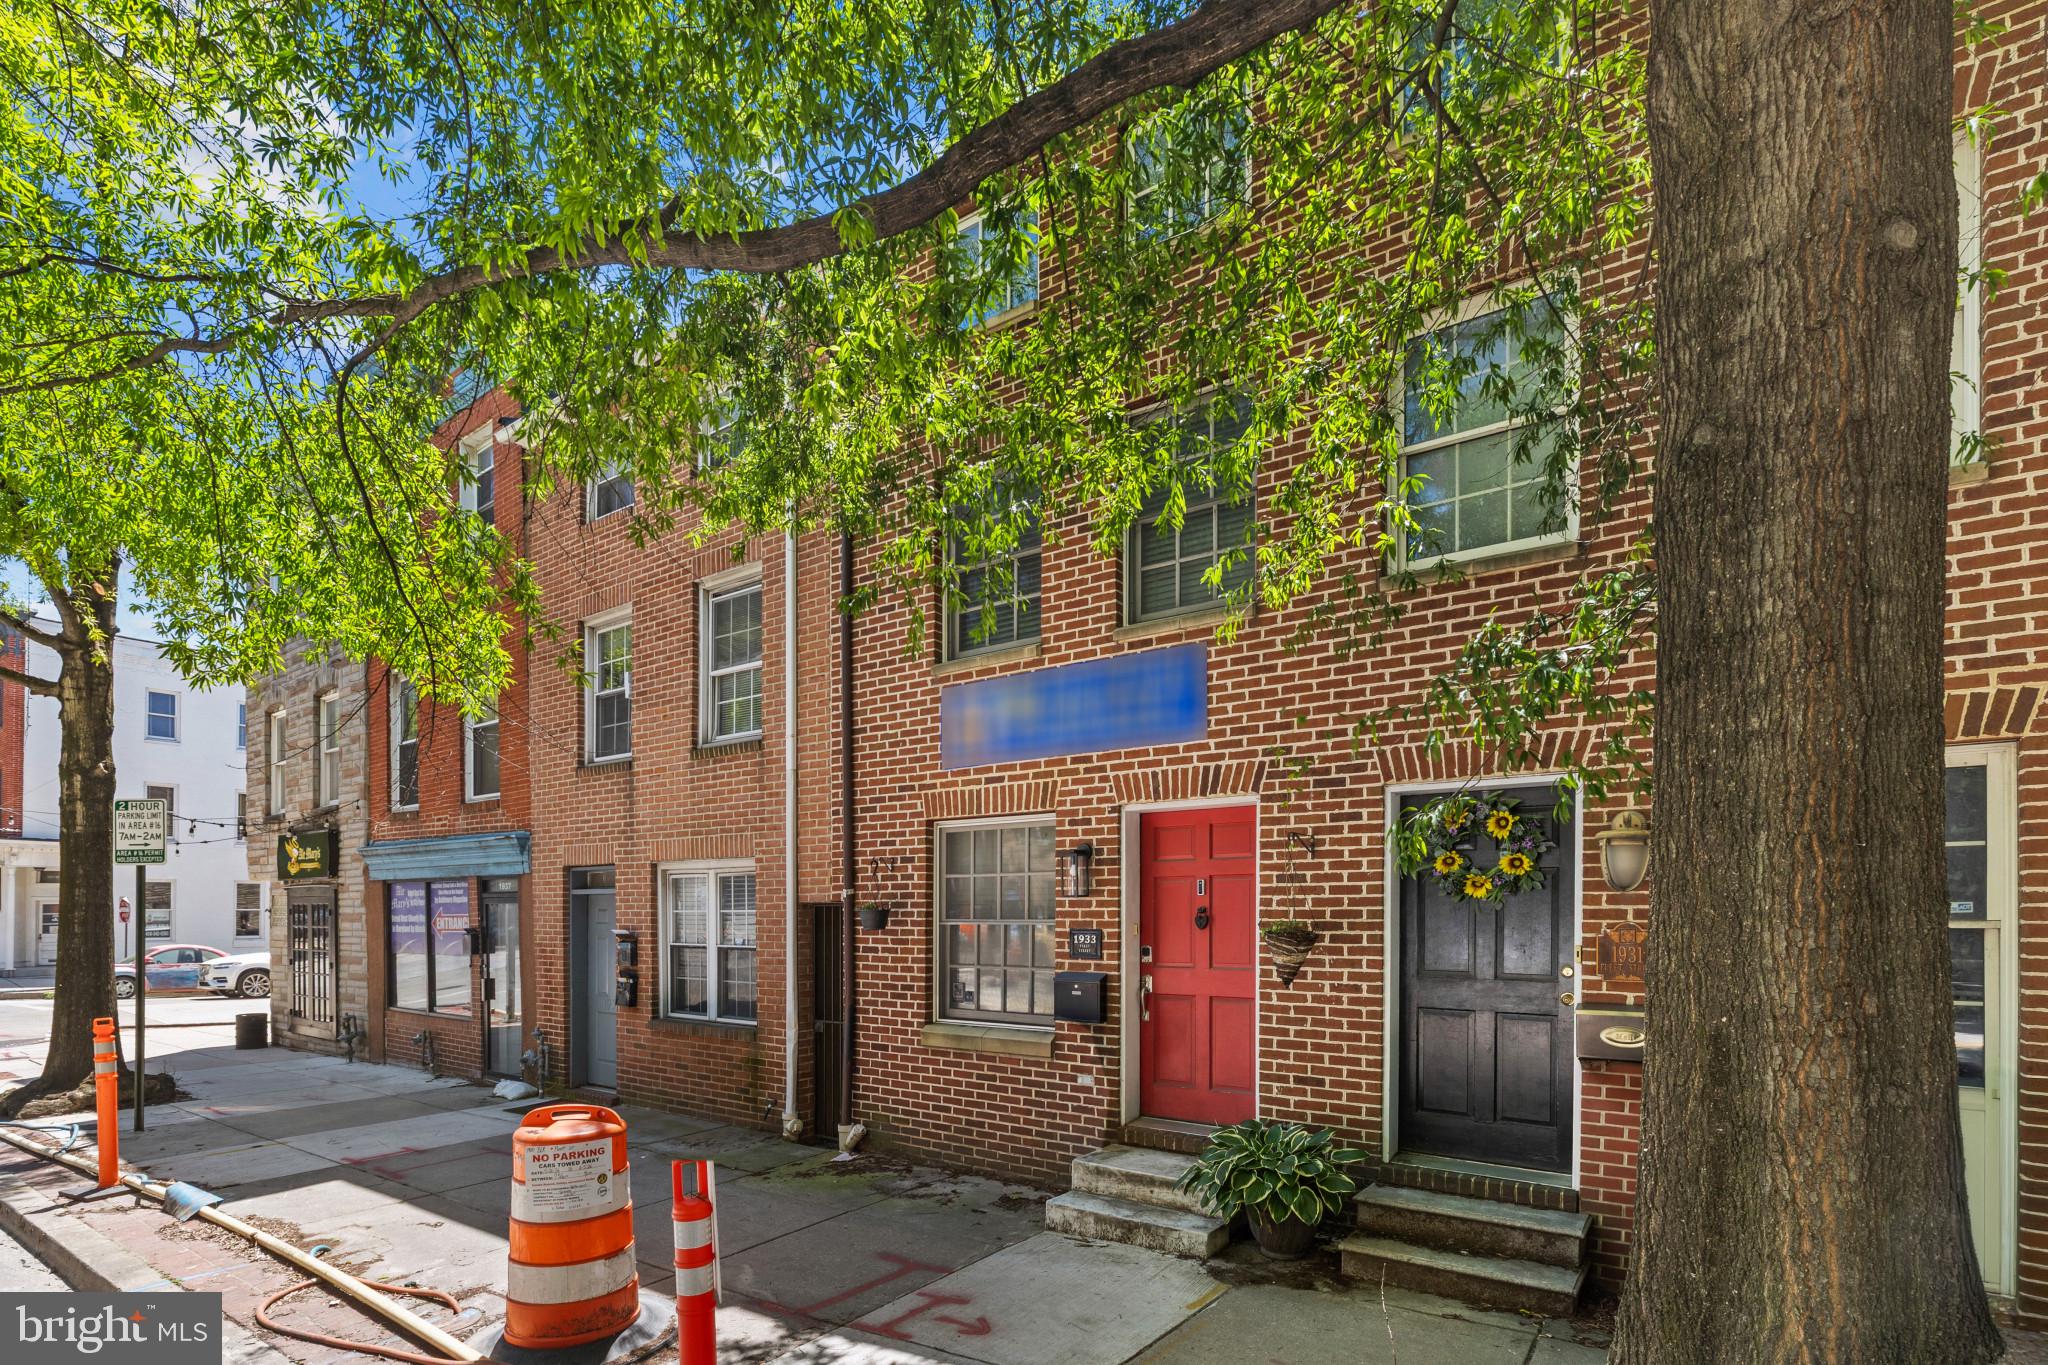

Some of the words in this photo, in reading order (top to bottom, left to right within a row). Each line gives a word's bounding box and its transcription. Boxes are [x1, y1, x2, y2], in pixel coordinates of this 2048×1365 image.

[119, 802, 126, 810] 2
[130, 802, 160, 811] HOUR
[117, 812, 145, 820] PARKING
[146, 812, 161, 820] LIMIT
[118, 822, 126, 830] IN
[128, 821, 148, 830] AREA
[436, 917, 469, 930] ENTRANC
[1073, 934, 1096, 944] 1933
[1612, 945, 1642, 963] 1931
[532, 1153, 549, 1163] NO
[553, 1147, 605, 1162] PARKING
[557, 1160, 581, 1168] TOWED
[582, 1157, 600, 1165] AWAY
